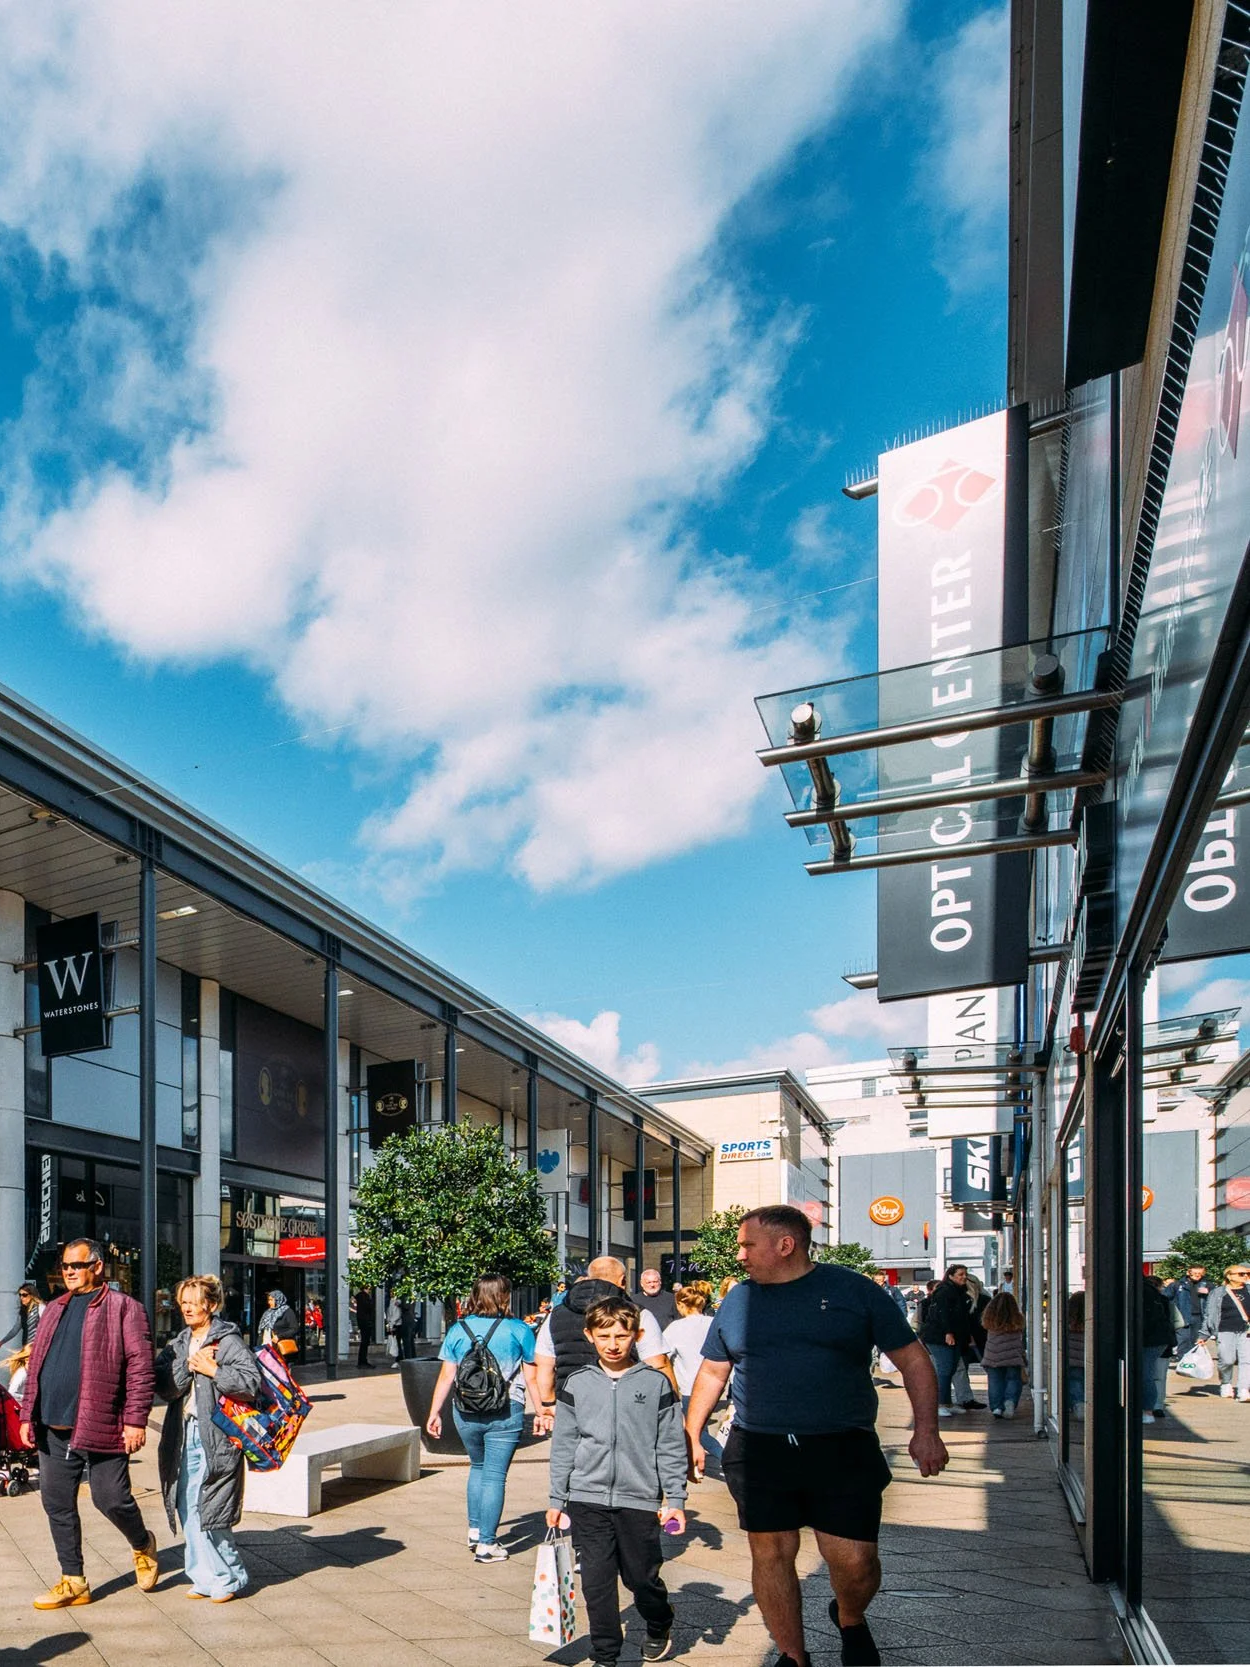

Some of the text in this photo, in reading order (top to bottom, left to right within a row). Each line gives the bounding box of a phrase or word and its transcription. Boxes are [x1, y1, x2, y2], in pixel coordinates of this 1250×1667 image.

[930, 757, 973, 953] OPTCL
[44, 951, 93, 1000] W
[43, 1001, 99, 1018] WATERSTONES
[721, 1140, 771, 1153] SPORTS
